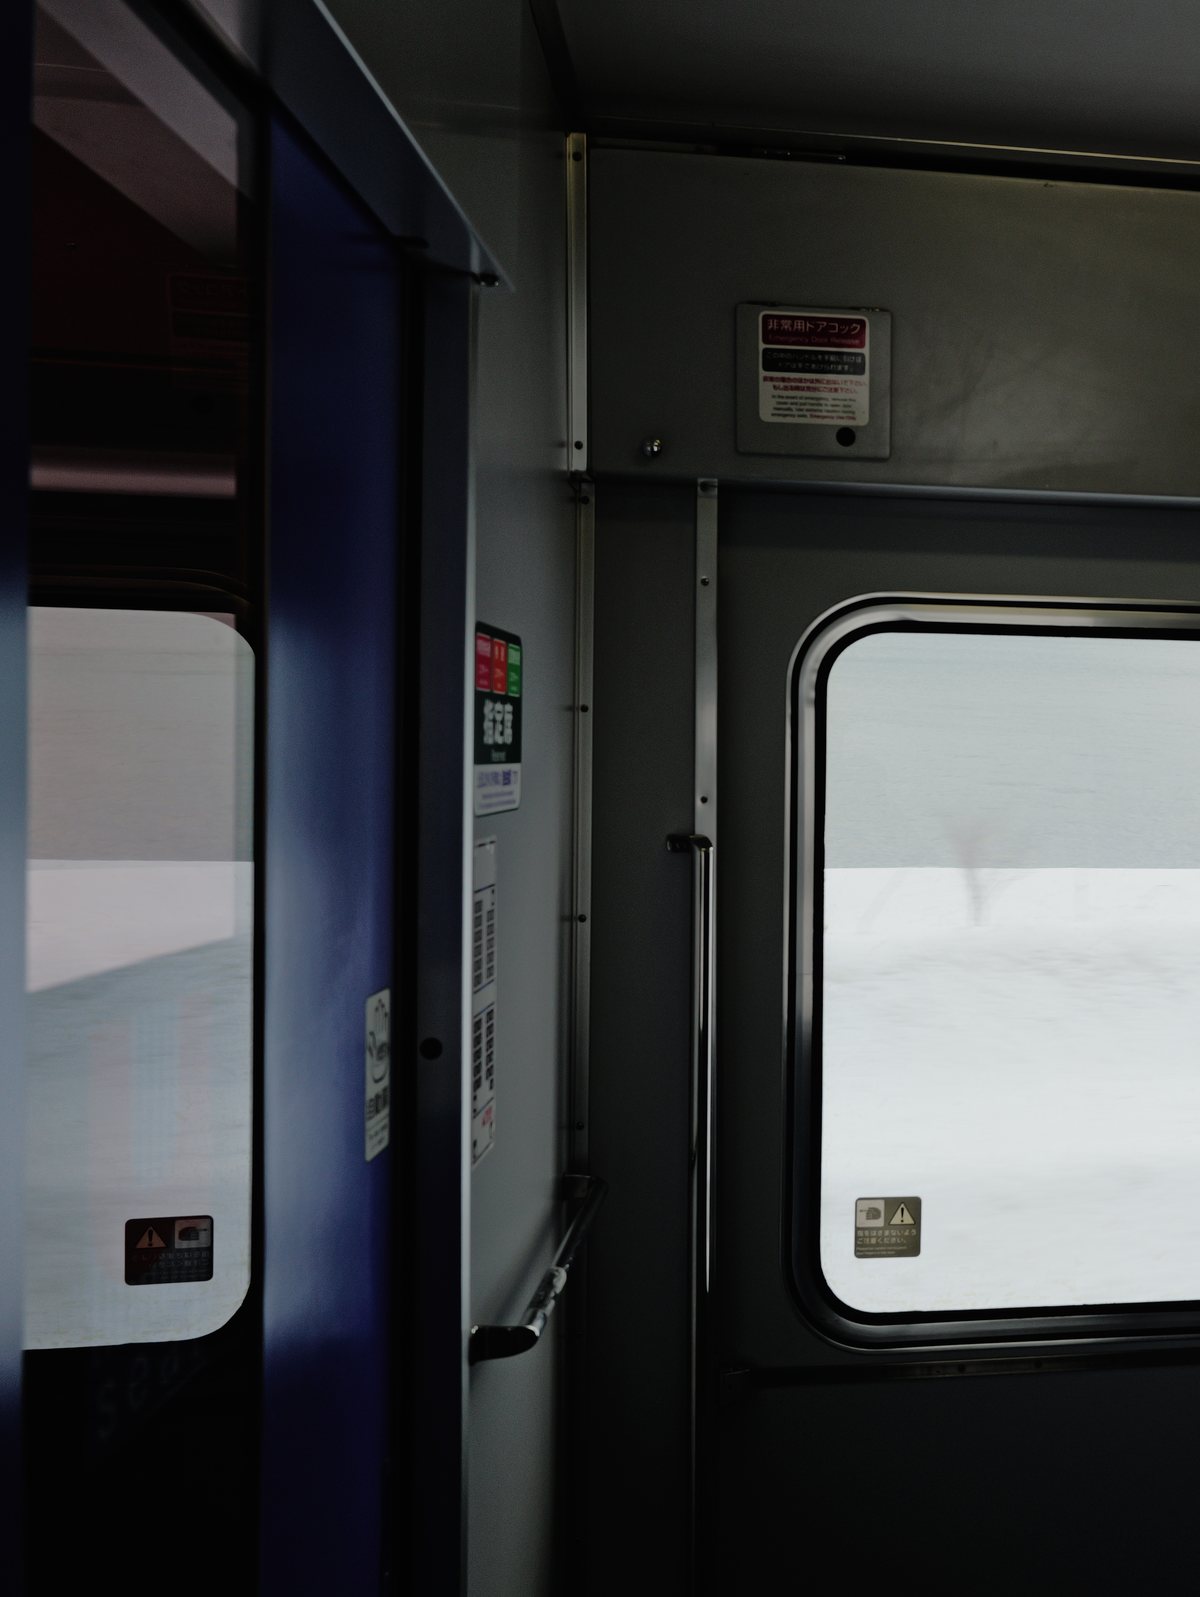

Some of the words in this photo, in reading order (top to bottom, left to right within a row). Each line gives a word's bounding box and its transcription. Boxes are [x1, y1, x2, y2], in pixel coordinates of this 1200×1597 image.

[767, 318, 861, 335] 非常用ドアコック
